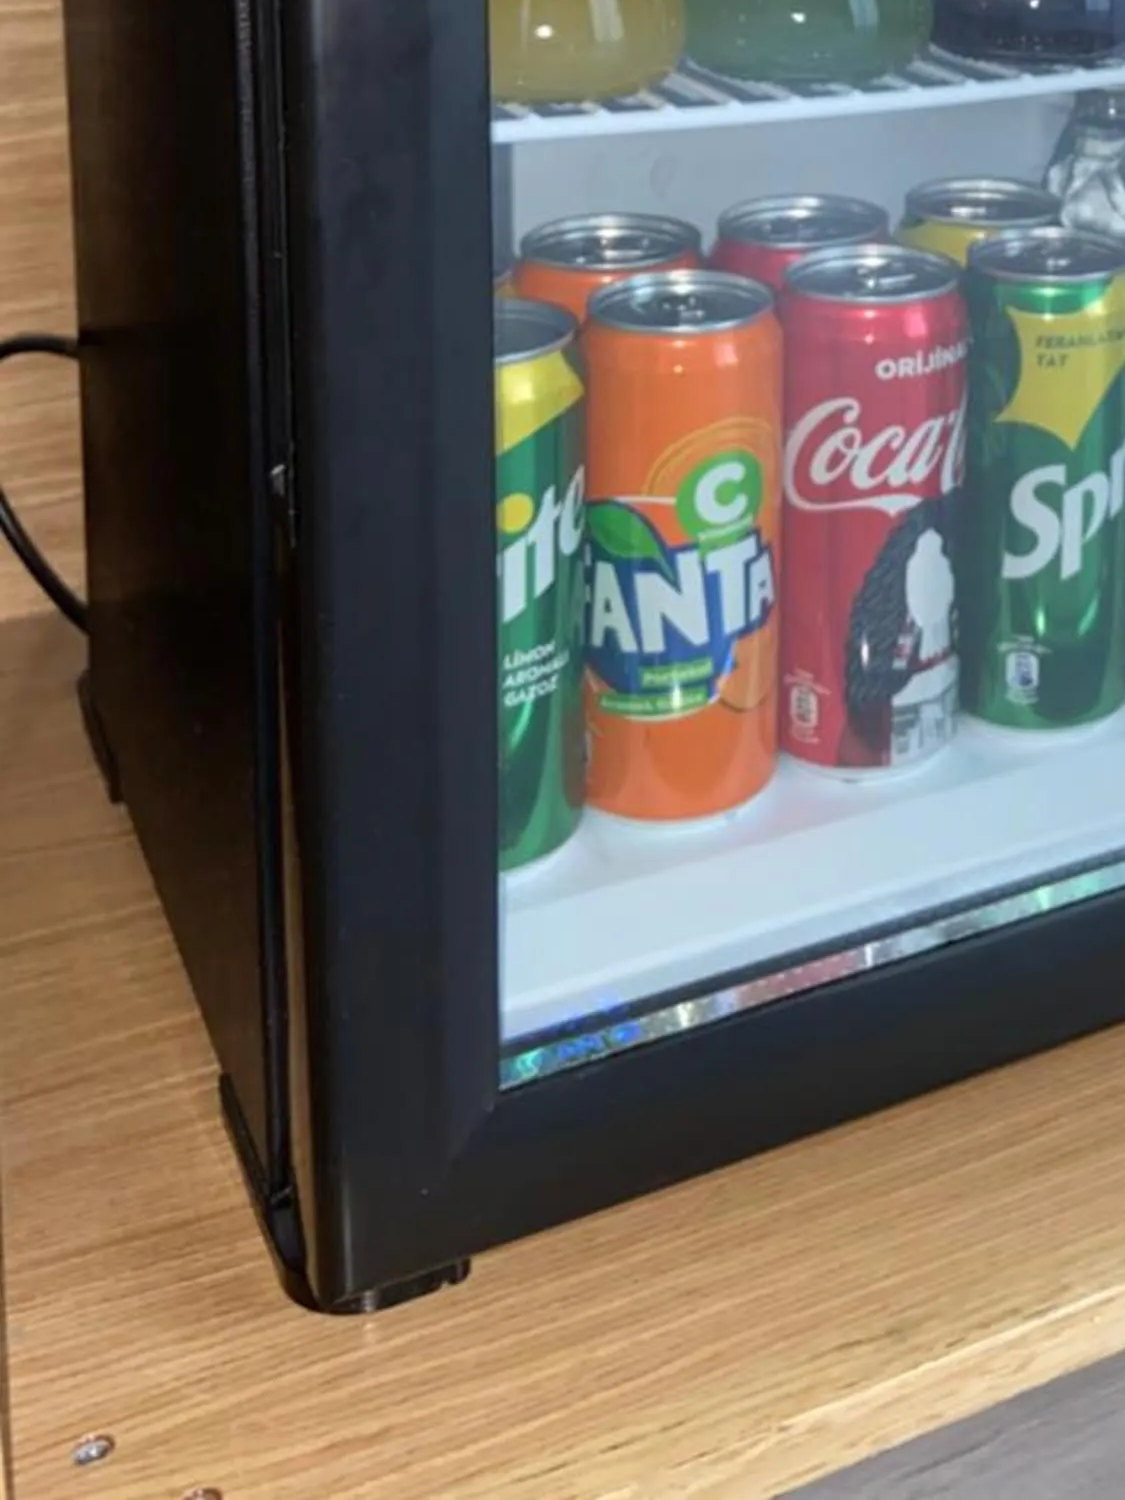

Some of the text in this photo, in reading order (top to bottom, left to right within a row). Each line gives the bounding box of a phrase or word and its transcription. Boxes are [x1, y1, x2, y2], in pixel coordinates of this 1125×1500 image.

[1035, 352, 1069, 368] TAT
[694, 461, 748, 524] C
[583, 533, 775, 654] ANTA
